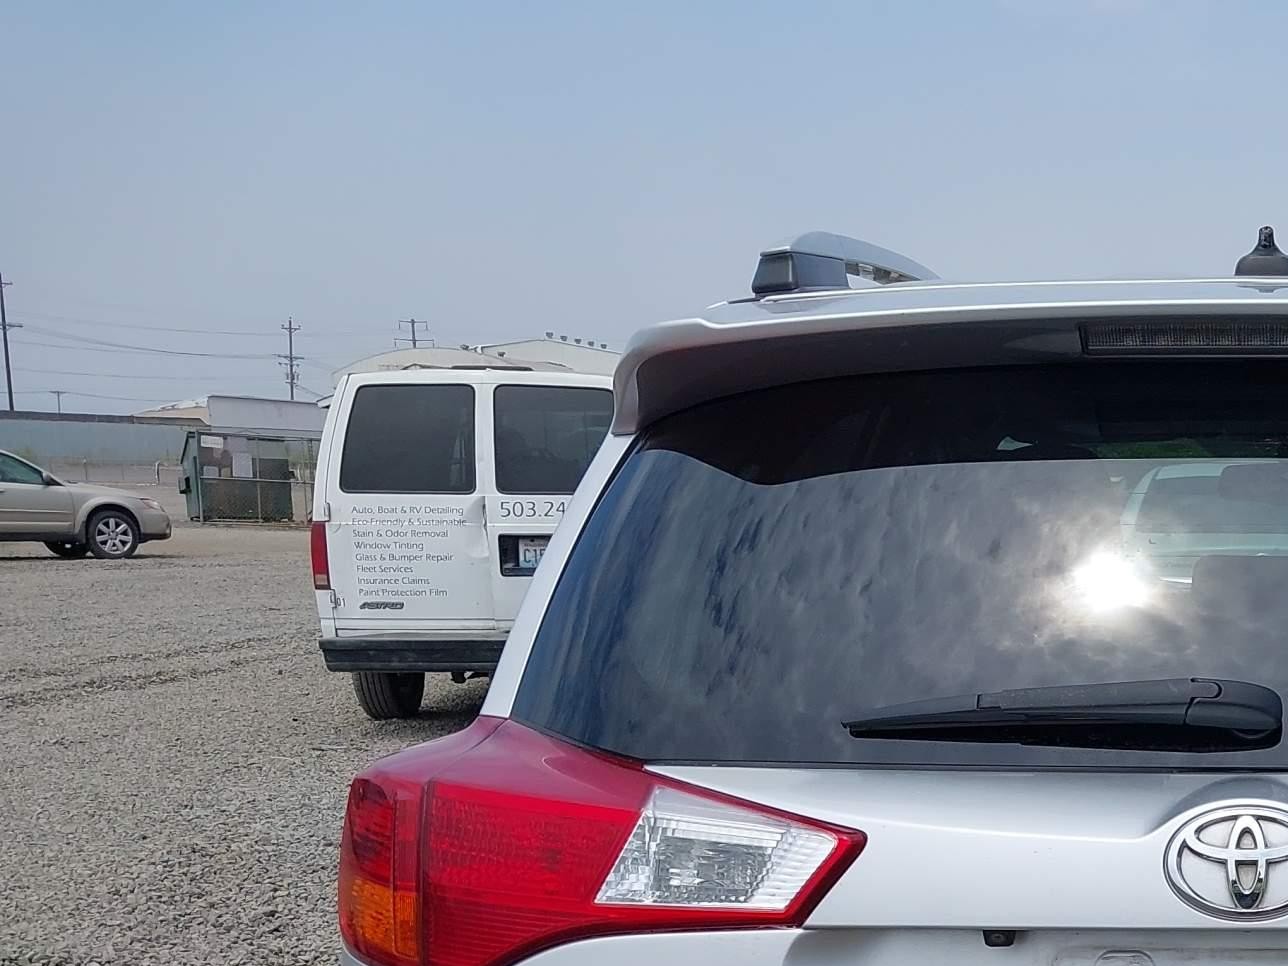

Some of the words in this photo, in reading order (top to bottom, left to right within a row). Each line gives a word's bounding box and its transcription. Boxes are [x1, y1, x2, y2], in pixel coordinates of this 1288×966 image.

[351, 505, 375, 515] Auto,
[377, 505, 398, 514] Boat
[400, 505, 407, 514] &
[409, 505, 422, 514] RV
[424, 505, 464, 516] Detailing
[351, 517, 405, 528] Eco-Friendly
[408, 517, 415, 526] &
[416, 517, 467, 527] Sustainable
[352, 529, 374, 538] Stain
[376, 529, 383, 538] &
[385, 529, 408, 538] Odor
[410, 529, 449, 538] Removal
[354, 541, 391, 550] Window
[393, 541, 424, 551] Tinting
[355, 553, 378, 562] Glass
[379, 553, 386, 562] &
[388, 553, 423, 563] Bumper
[425, 553, 453, 563] Repair
[356, 565, 377, 573] Fleet
[379, 565, 414, 573] Services
[357, 576, 400, 585] Insurance
[401, 576, 431, 585] Claims
[358, 588, 380, 597] Paint
[382, 588, 427, 597] Protection
[429, 588, 448, 597] Film
[359, 601, 405, 610] ASTRO
